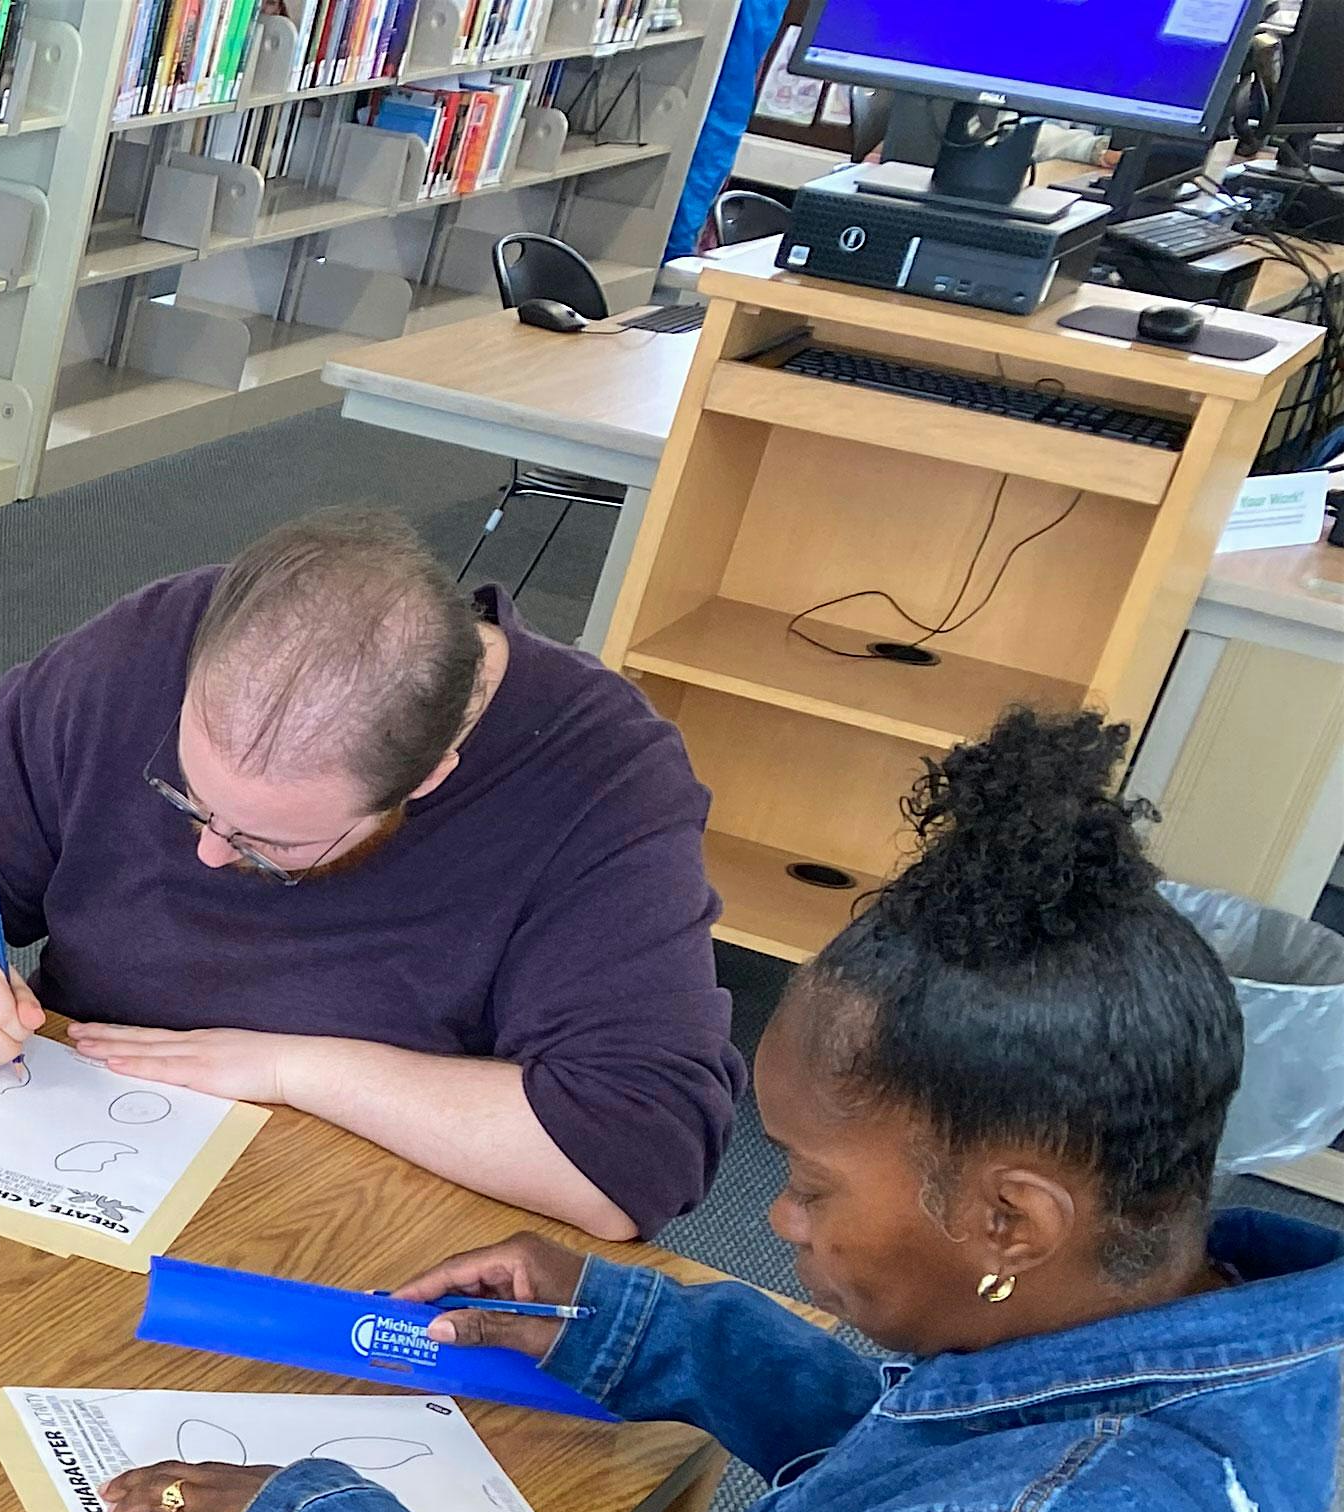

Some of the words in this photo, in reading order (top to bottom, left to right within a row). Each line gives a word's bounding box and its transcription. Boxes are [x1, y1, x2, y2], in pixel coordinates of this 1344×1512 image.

[26, 1198, 41, 1210] A
[48, 1201, 130, 1235] CREATE
[377, 1315, 430, 1337] Michiga
[372, 1341, 438, 1360] CHANNEL
[374, 1330, 440, 1352] LEARNING
